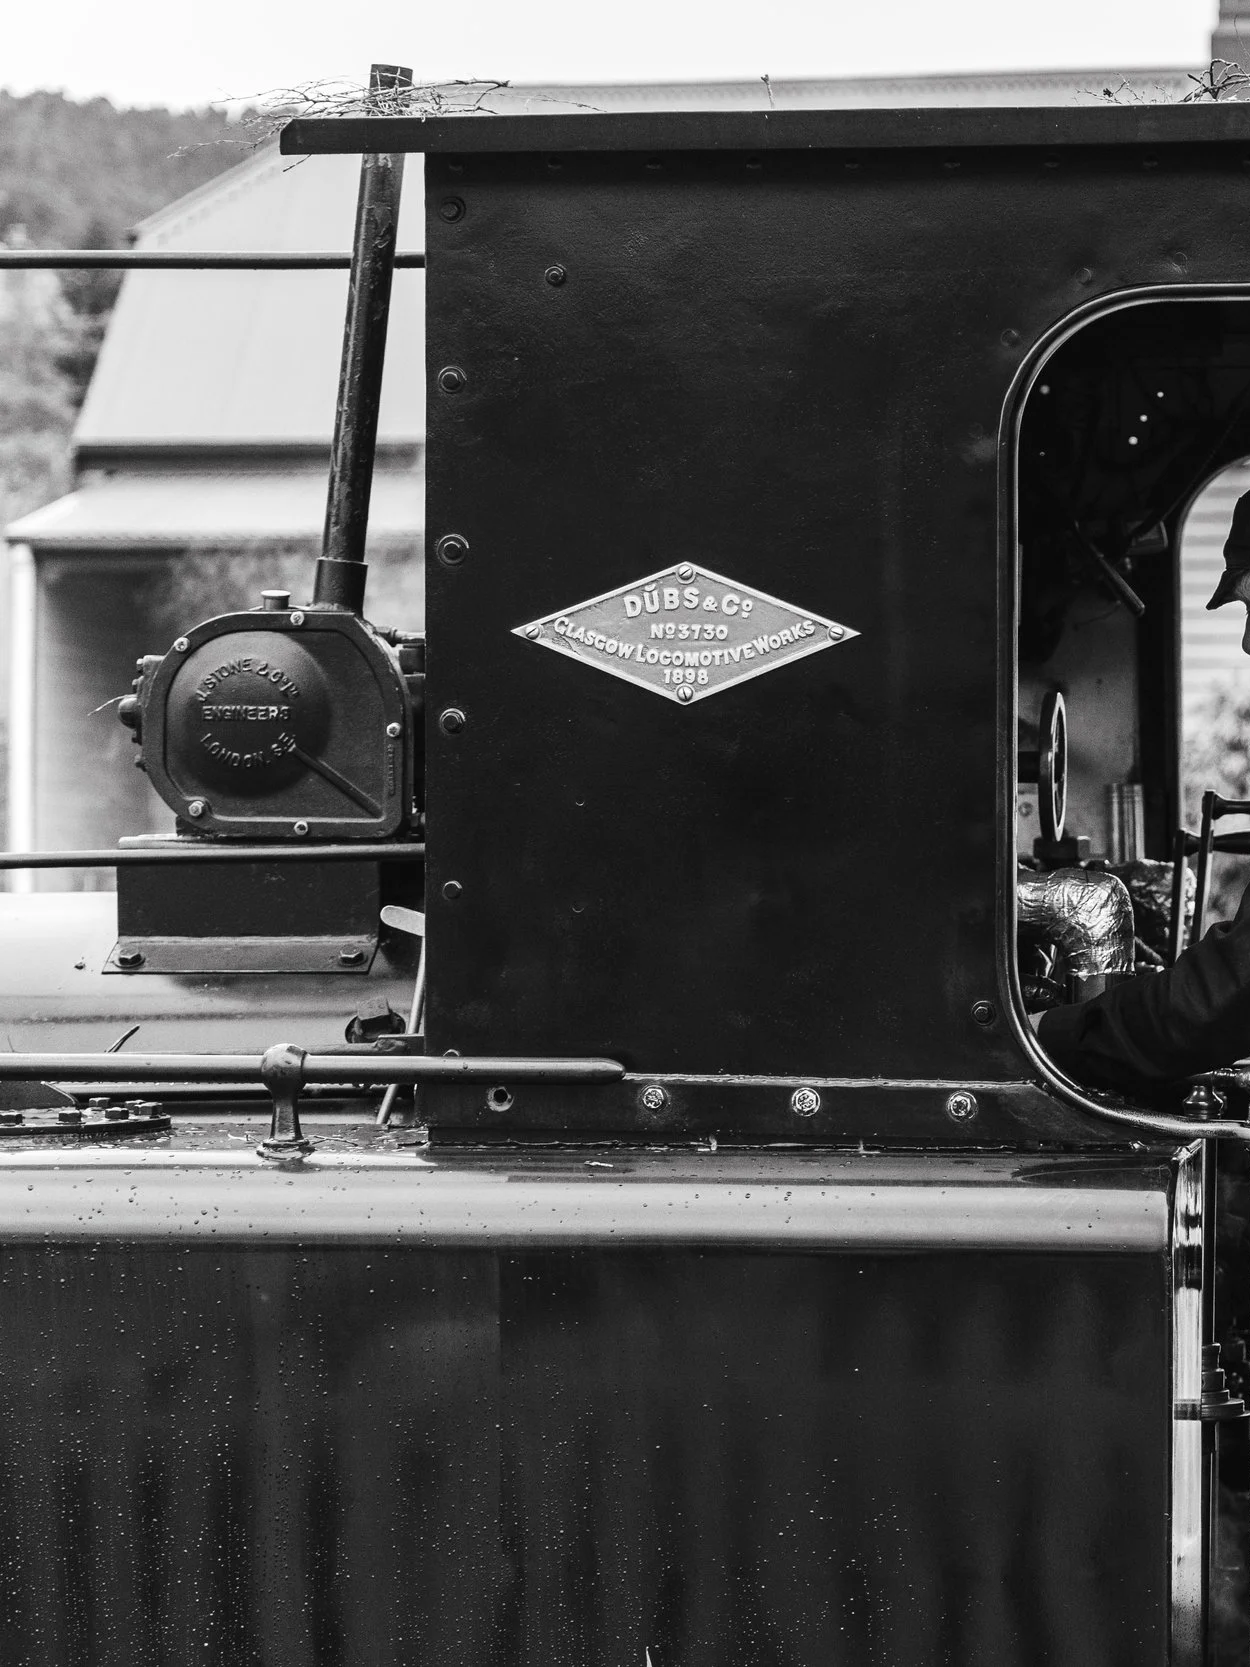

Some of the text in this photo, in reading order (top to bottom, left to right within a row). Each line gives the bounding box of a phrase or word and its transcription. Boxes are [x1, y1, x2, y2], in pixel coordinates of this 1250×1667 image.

[702, 596, 718, 613] &
[678, 623, 728, 640] 3730
[554, 616, 816, 667] GLASGOW LOCOMOTIVE WORKS
[663, 668, 709, 685] 1898
[202, 705, 291, 721] ENGINEERS
